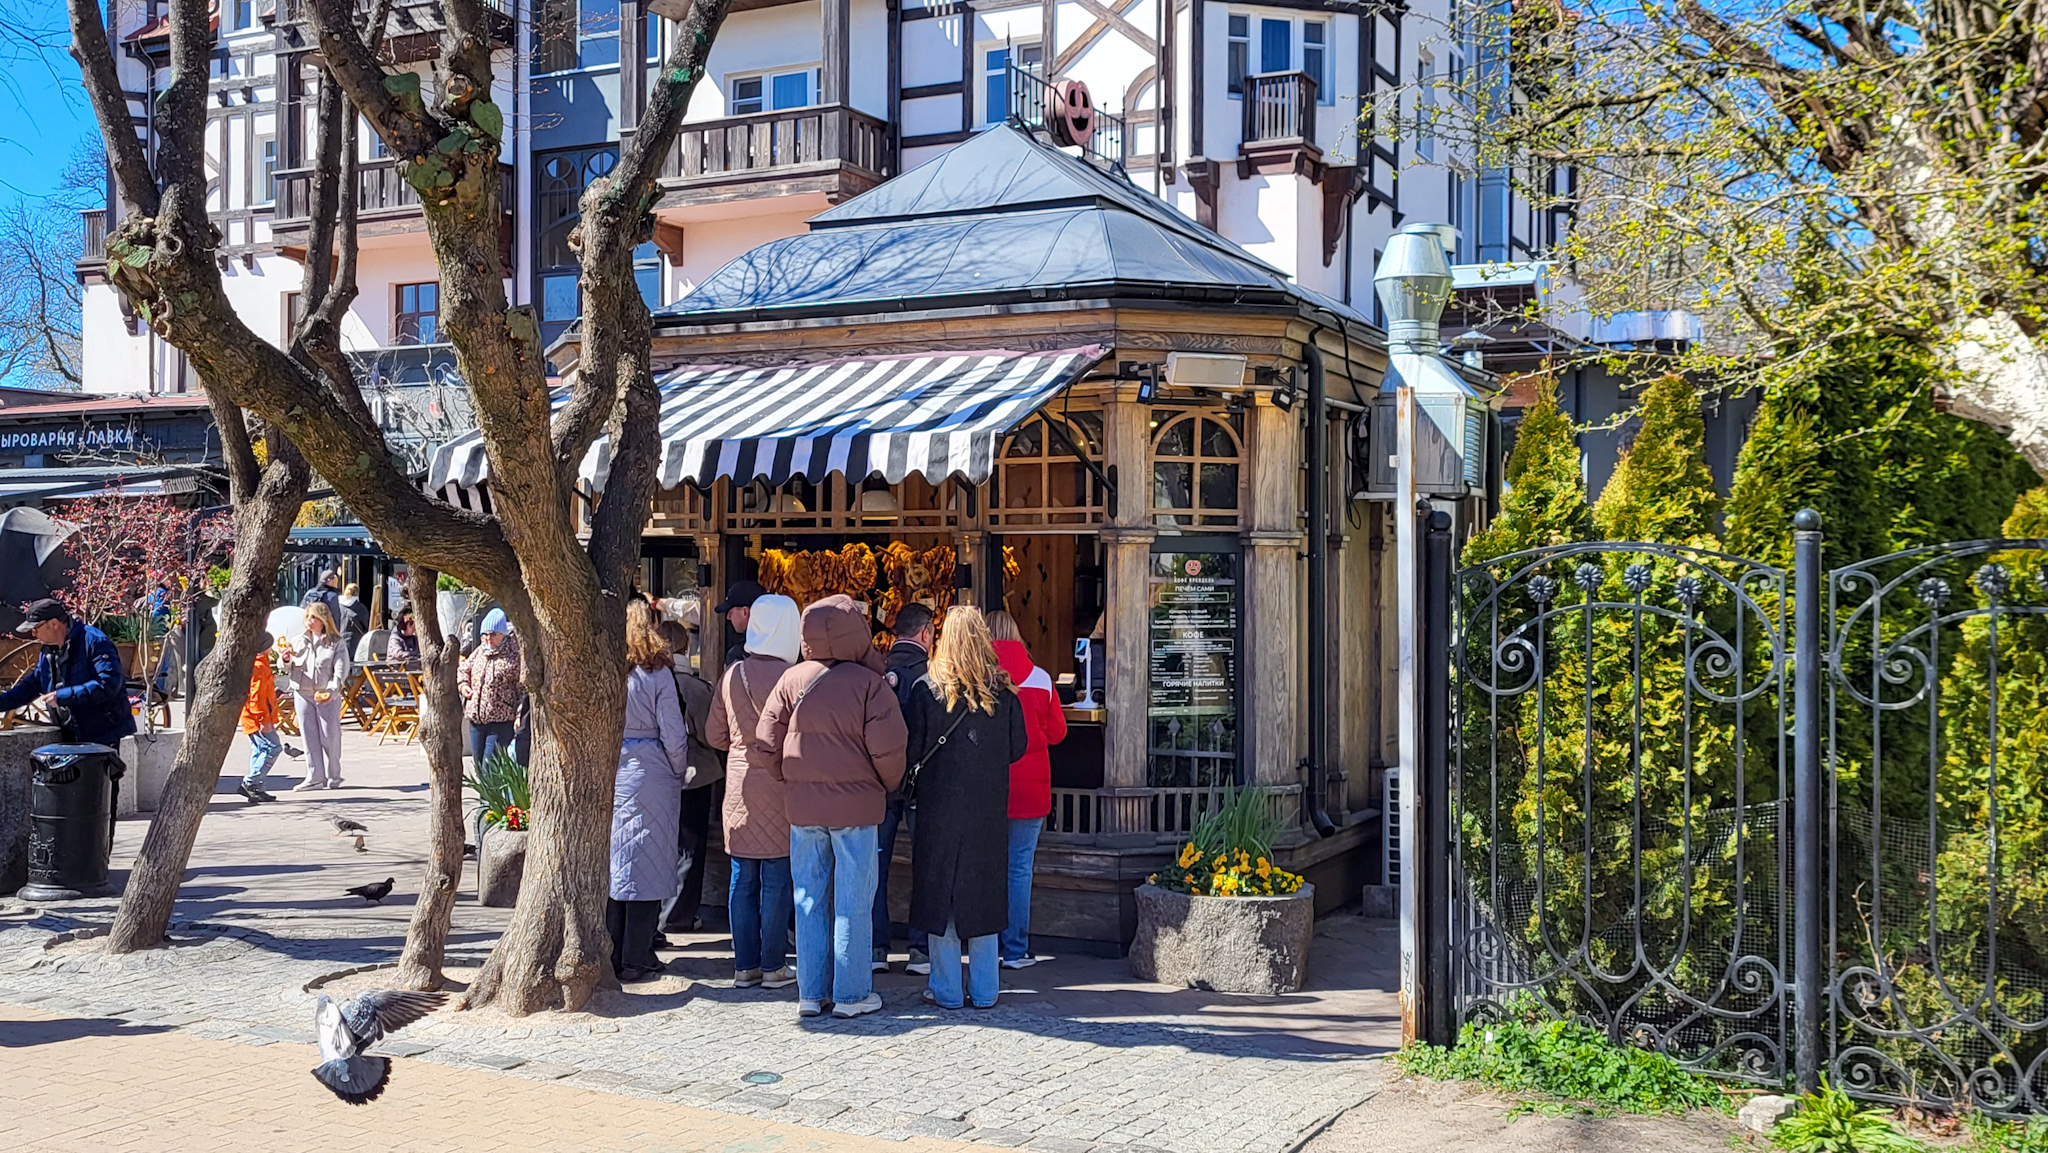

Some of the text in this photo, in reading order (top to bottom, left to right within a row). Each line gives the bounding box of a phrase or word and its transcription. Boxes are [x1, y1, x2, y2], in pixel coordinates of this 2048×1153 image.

[0, 429, 134, 448] ЫРОВАРНЯ ЛАВКА
[1182, 631, 1204, 639] КОФЕ
